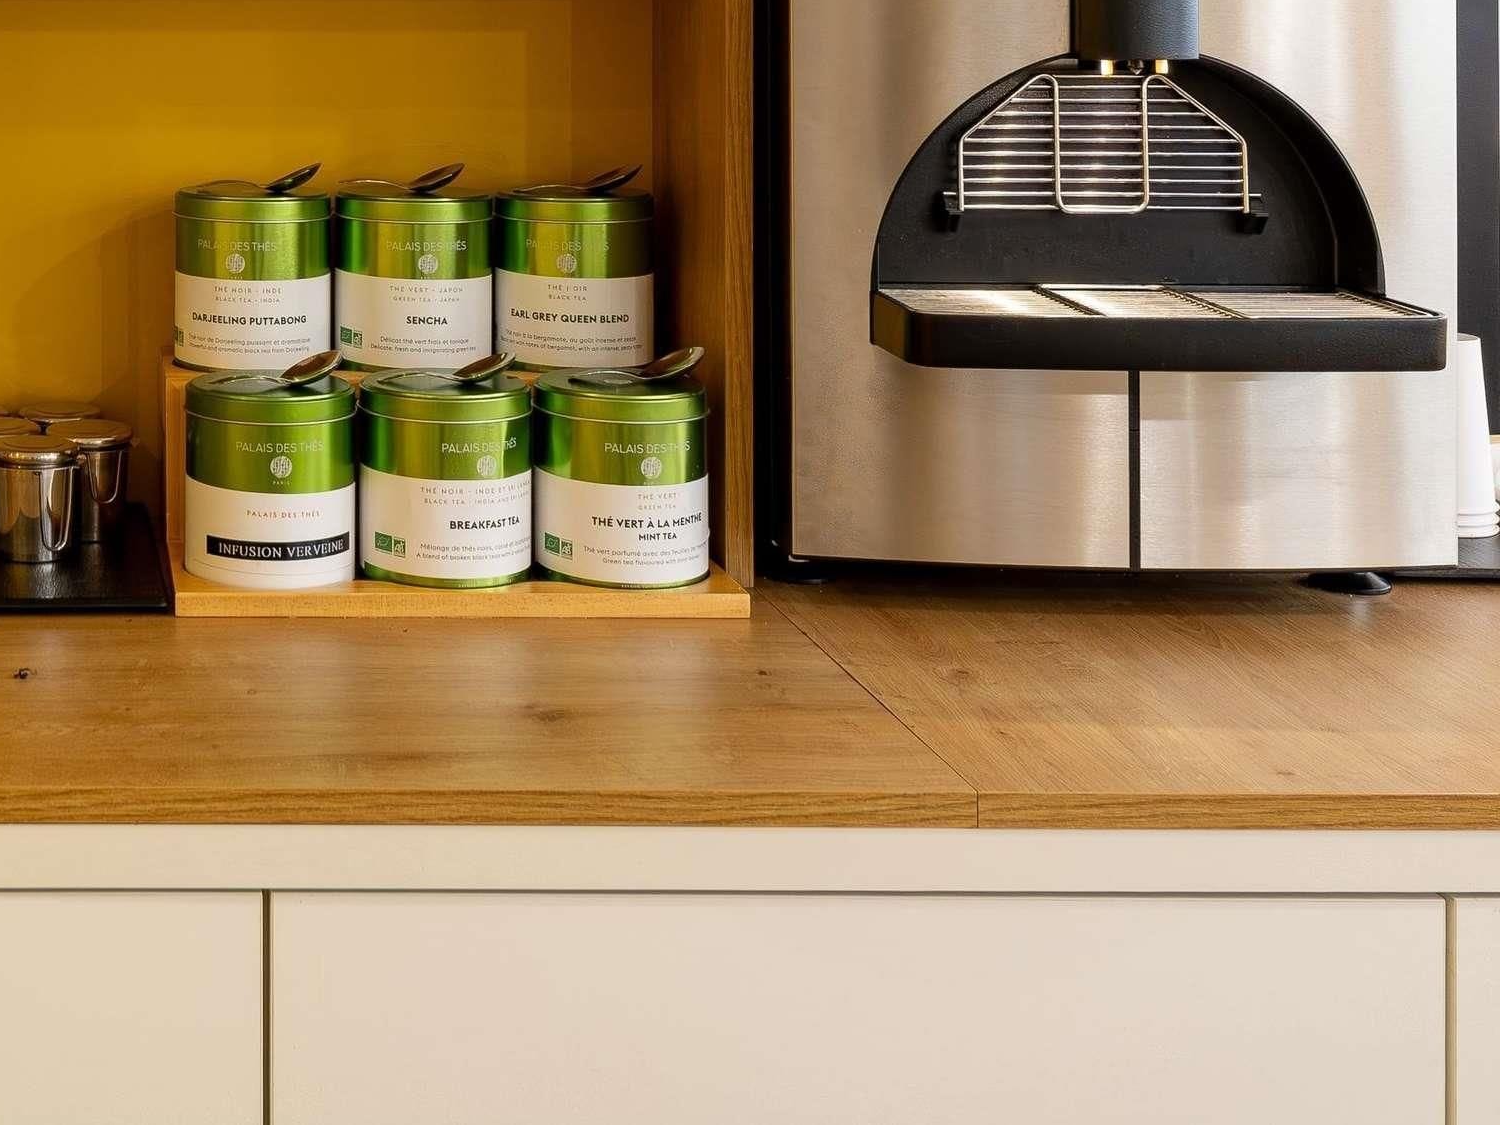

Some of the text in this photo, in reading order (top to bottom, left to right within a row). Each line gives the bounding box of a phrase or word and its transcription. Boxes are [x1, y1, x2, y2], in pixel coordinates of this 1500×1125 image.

[192, 312, 307, 326] DARJEELING PUTTABONG
[406, 316, 448, 326] SENCHA
[511, 308, 630, 325] EARL GREY QUEEN BLEND
[235, 441, 273, 454] PALAIS
[275, 442, 298, 454] DES
[441, 442, 480, 454] PALAIS
[604, 442, 644, 454] PALAIS
[246, 510, 278, 519] PALAIS
[281, 511, 297, 519] DES
[591, 516, 613, 528] THÉ
[616, 519, 644, 529] VERT
[657, 519, 670, 528] LA
[672, 512, 702, 528] MENTHE
[449, 516, 520, 531] BREAKFAST TEA
[638, 532, 677, 542] MINT TEA
[218, 539, 344, 559] INFUSION VERVEINE
